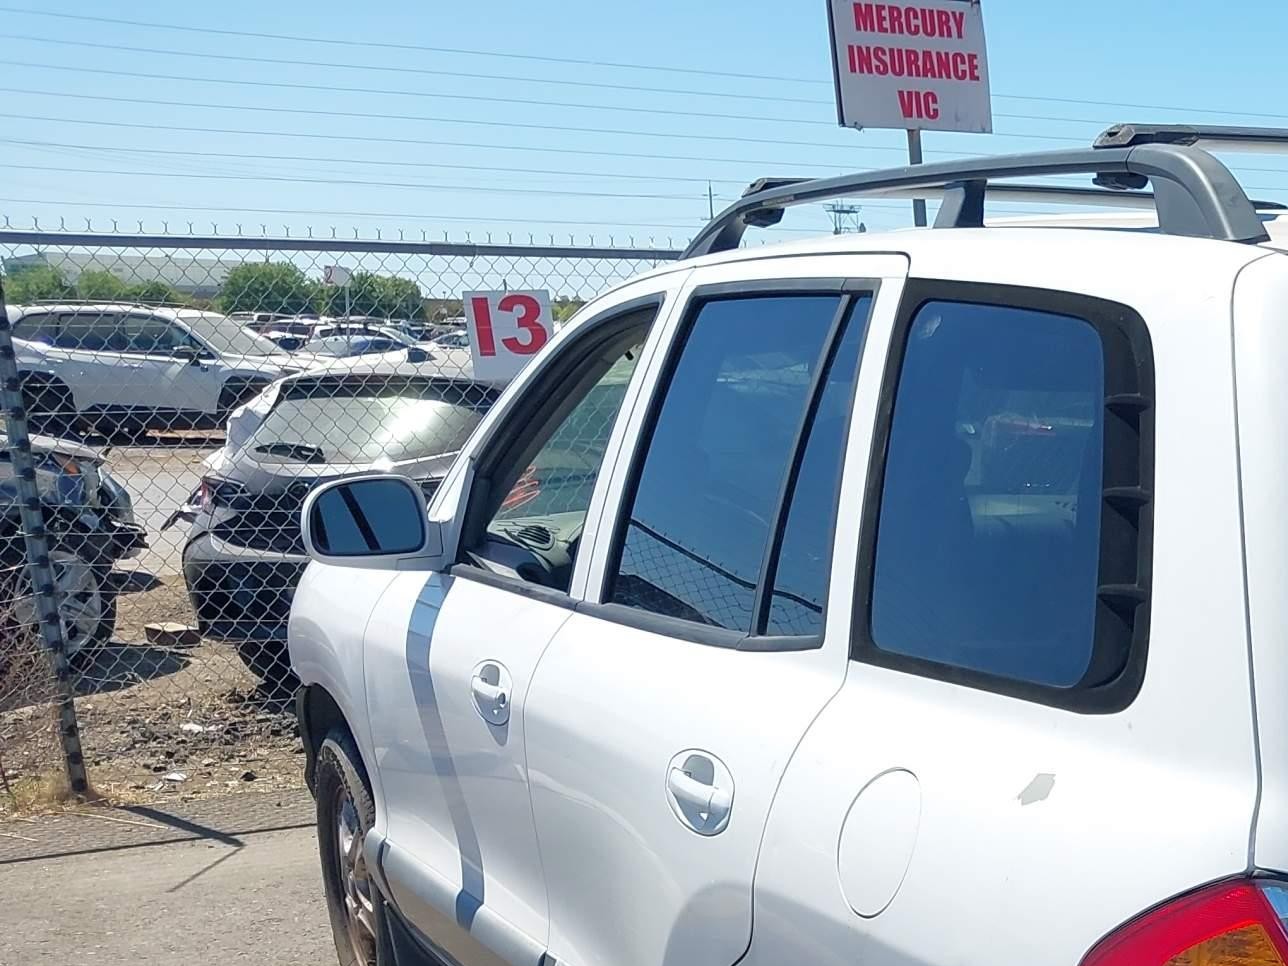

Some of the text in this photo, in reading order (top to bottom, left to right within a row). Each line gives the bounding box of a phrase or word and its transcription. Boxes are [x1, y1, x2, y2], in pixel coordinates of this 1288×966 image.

[853, 3, 965, 38] MERCURY
[847, 44, 980, 81] INSURANCE
[897, 90, 939, 120] VIC
[471, 294, 548, 356] 13
